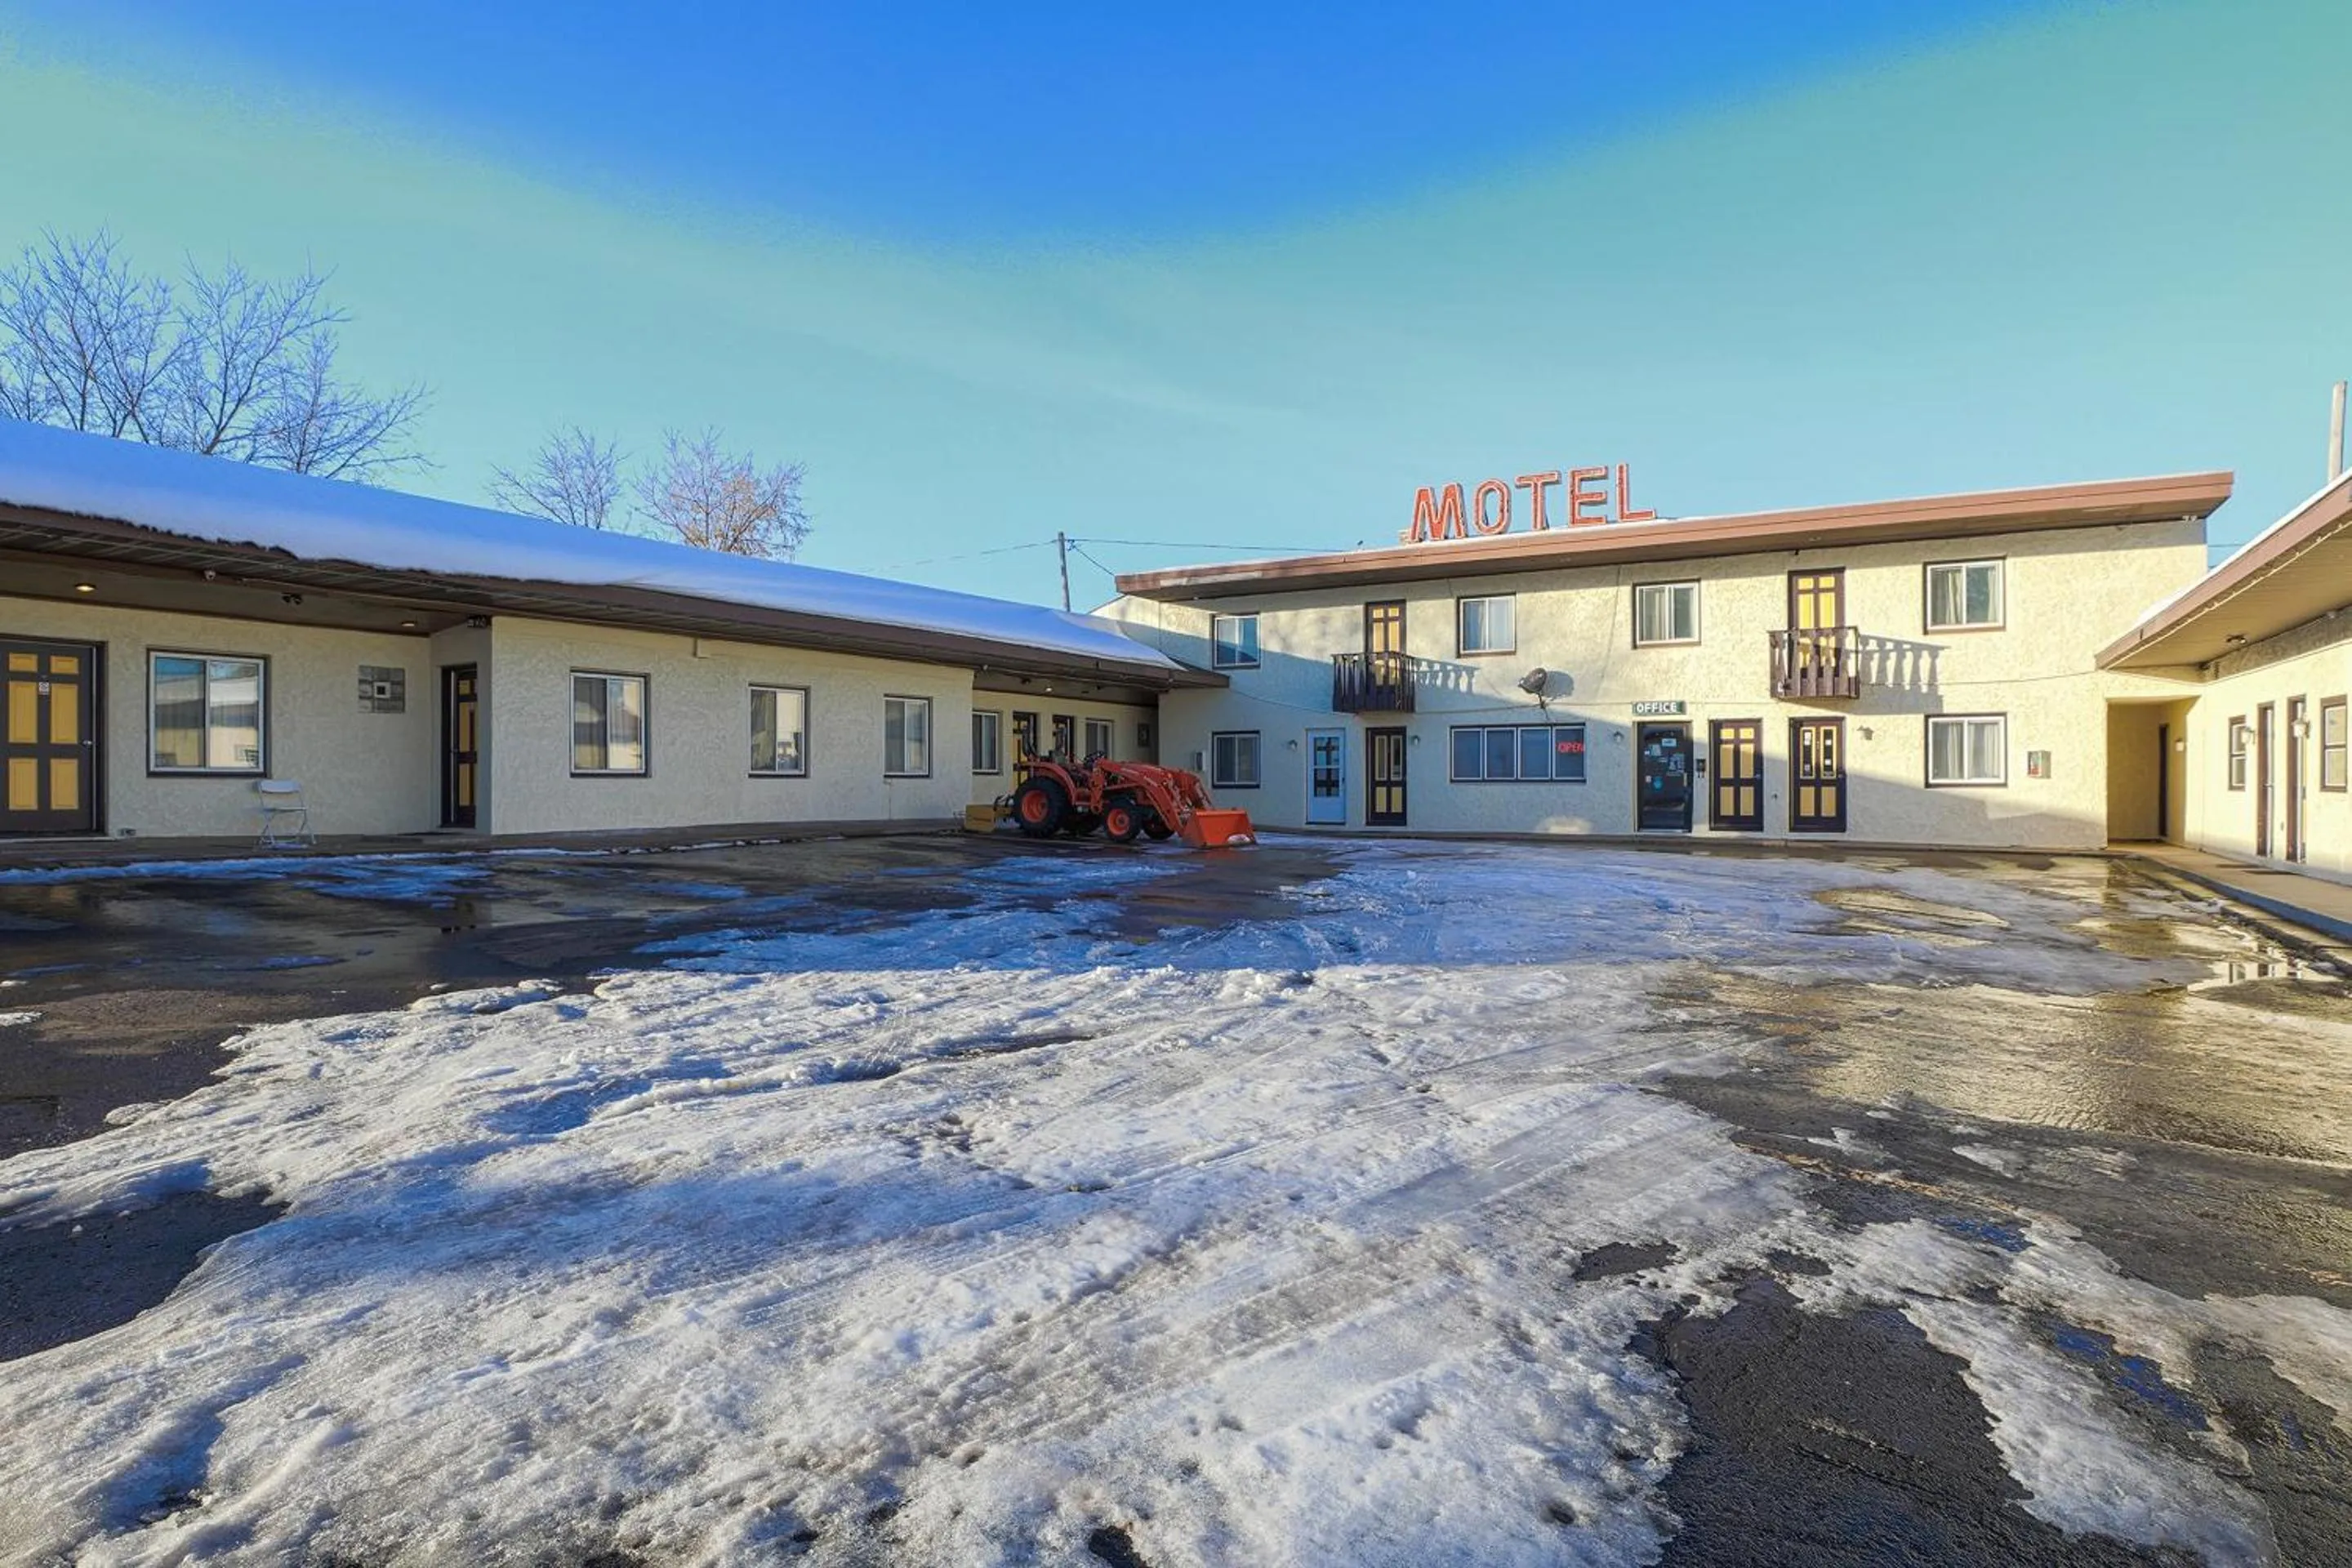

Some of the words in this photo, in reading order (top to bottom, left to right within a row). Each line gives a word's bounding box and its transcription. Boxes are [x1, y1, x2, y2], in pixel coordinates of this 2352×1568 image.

[1410, 463, 1656, 541] MOTEL
[1637, 702, 1677, 712] OFFICE
[1558, 742, 1585, 752] OPEN
